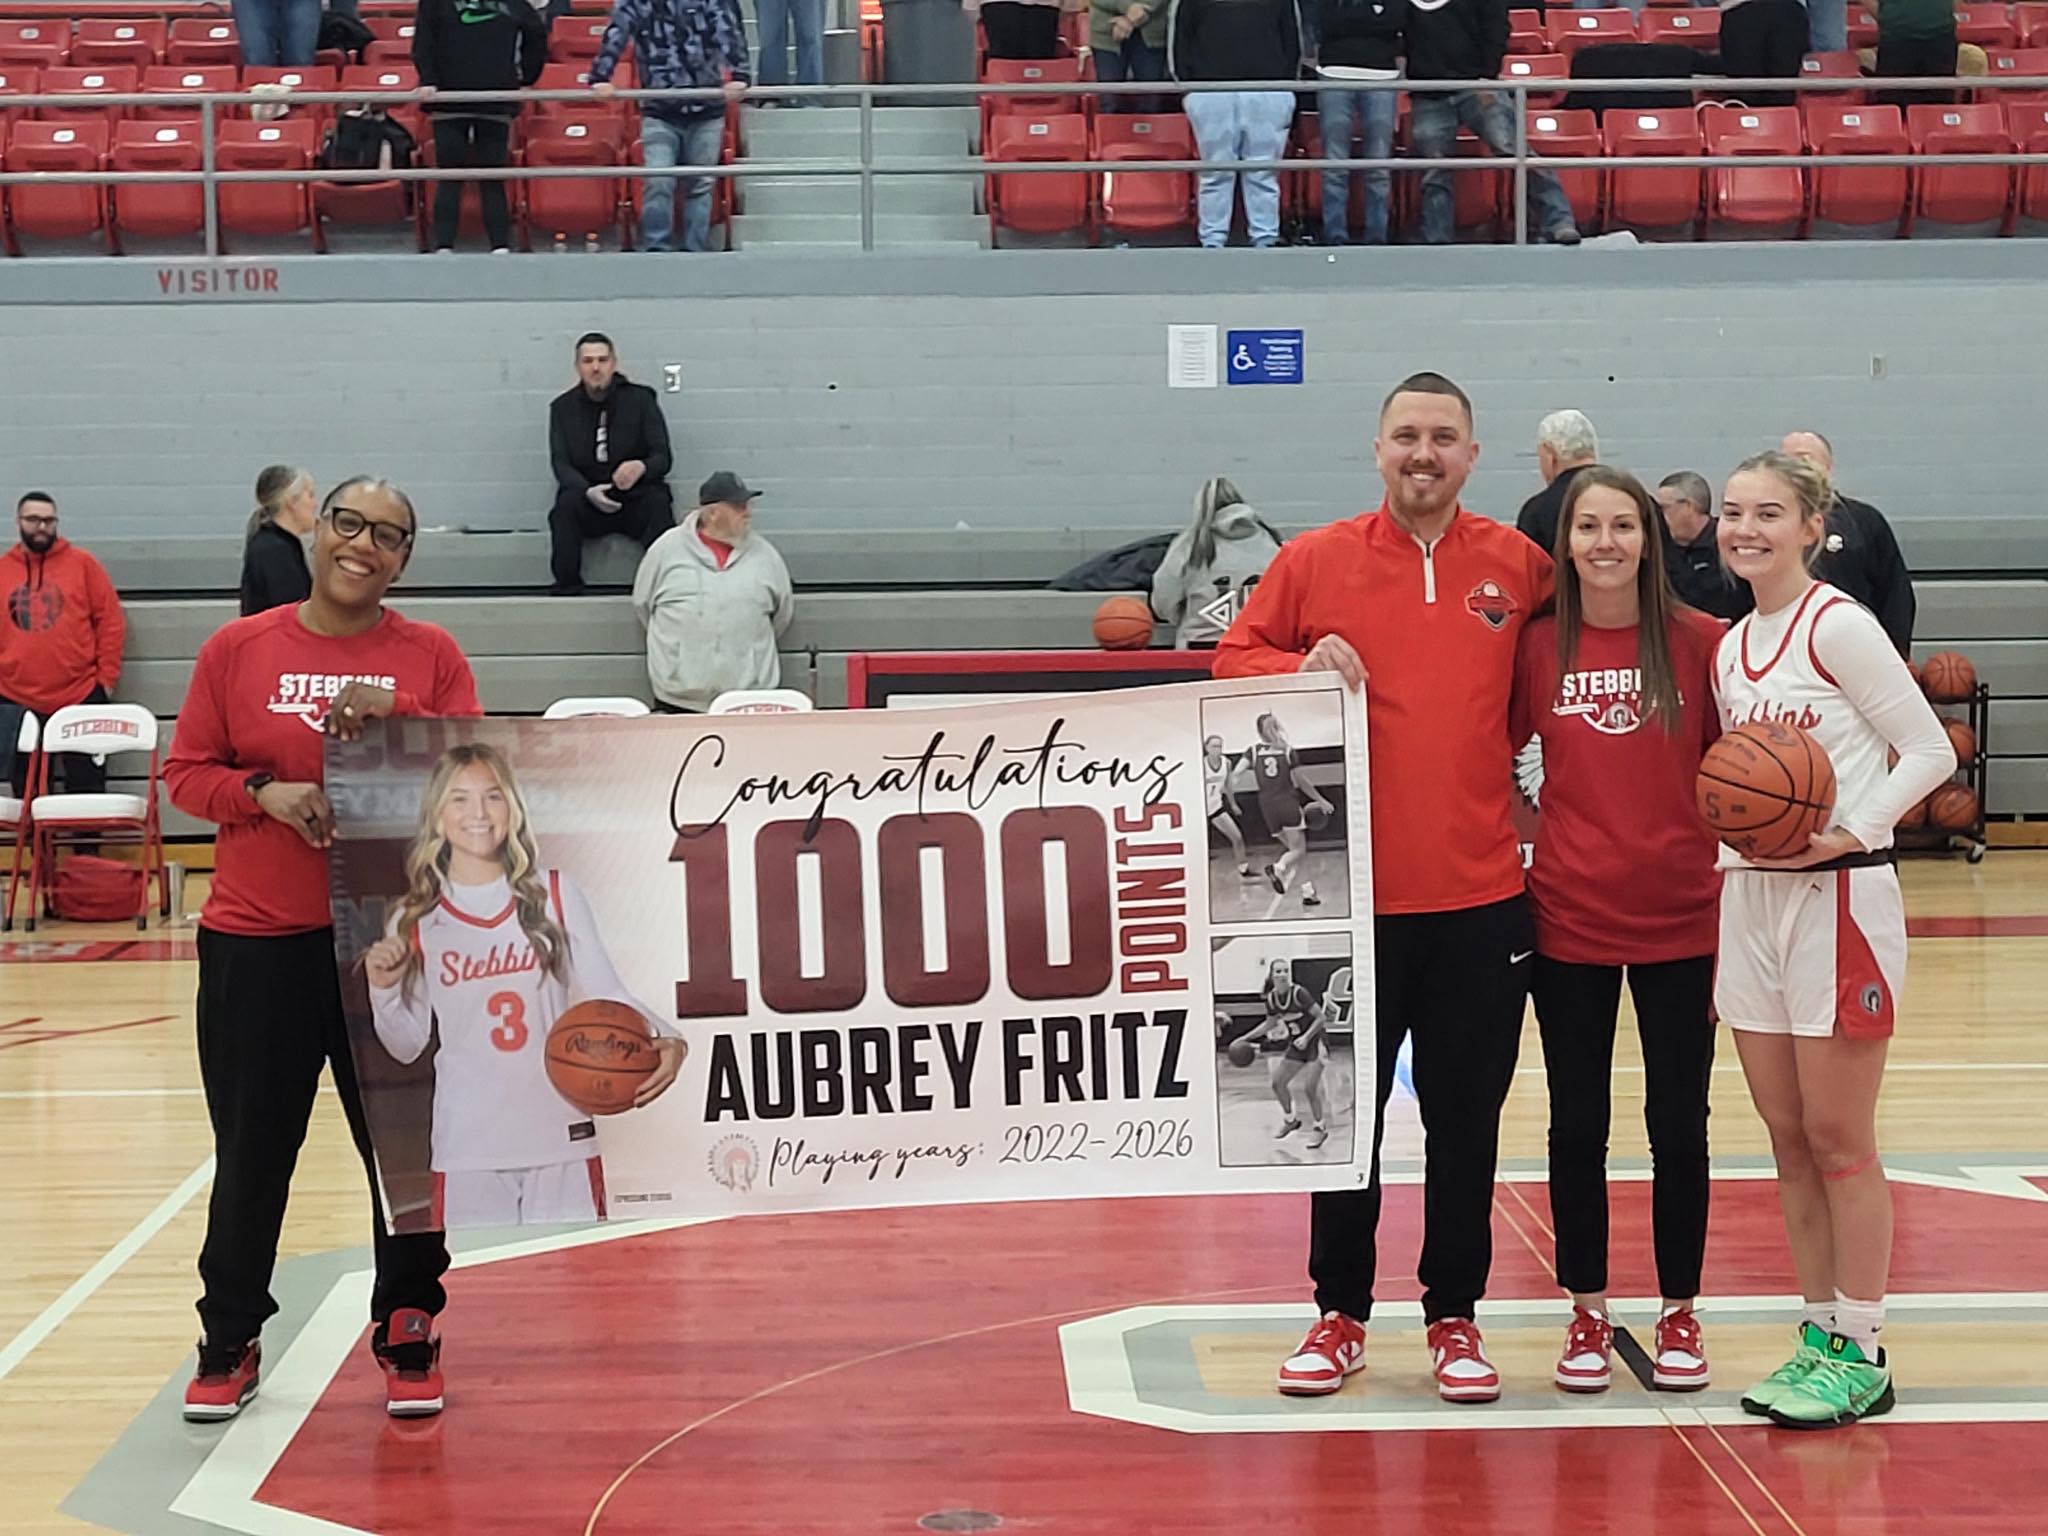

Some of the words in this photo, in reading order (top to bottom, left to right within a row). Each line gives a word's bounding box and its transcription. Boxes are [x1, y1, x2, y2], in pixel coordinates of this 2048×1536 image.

[157, 267, 279, 294] VISITOR
[1562, 668, 1642, 697] STEBBI
[669, 718, 1184, 845] Congratulations
[668, 805, 1113, 1019] 1000
[1114, 803, 1188, 994] POINTS
[440, 942, 538, 987] Stebbi
[488, 992, 528, 1052] 3
[703, 1021, 983, 1122] AUBREY
[1001, 1009, 1190, 1107] FRITZ
[769, 1137, 889, 1187] Playing
[897, 1141, 986, 1184] years:
[999, 1119, 1194, 1165] 2022-2026
